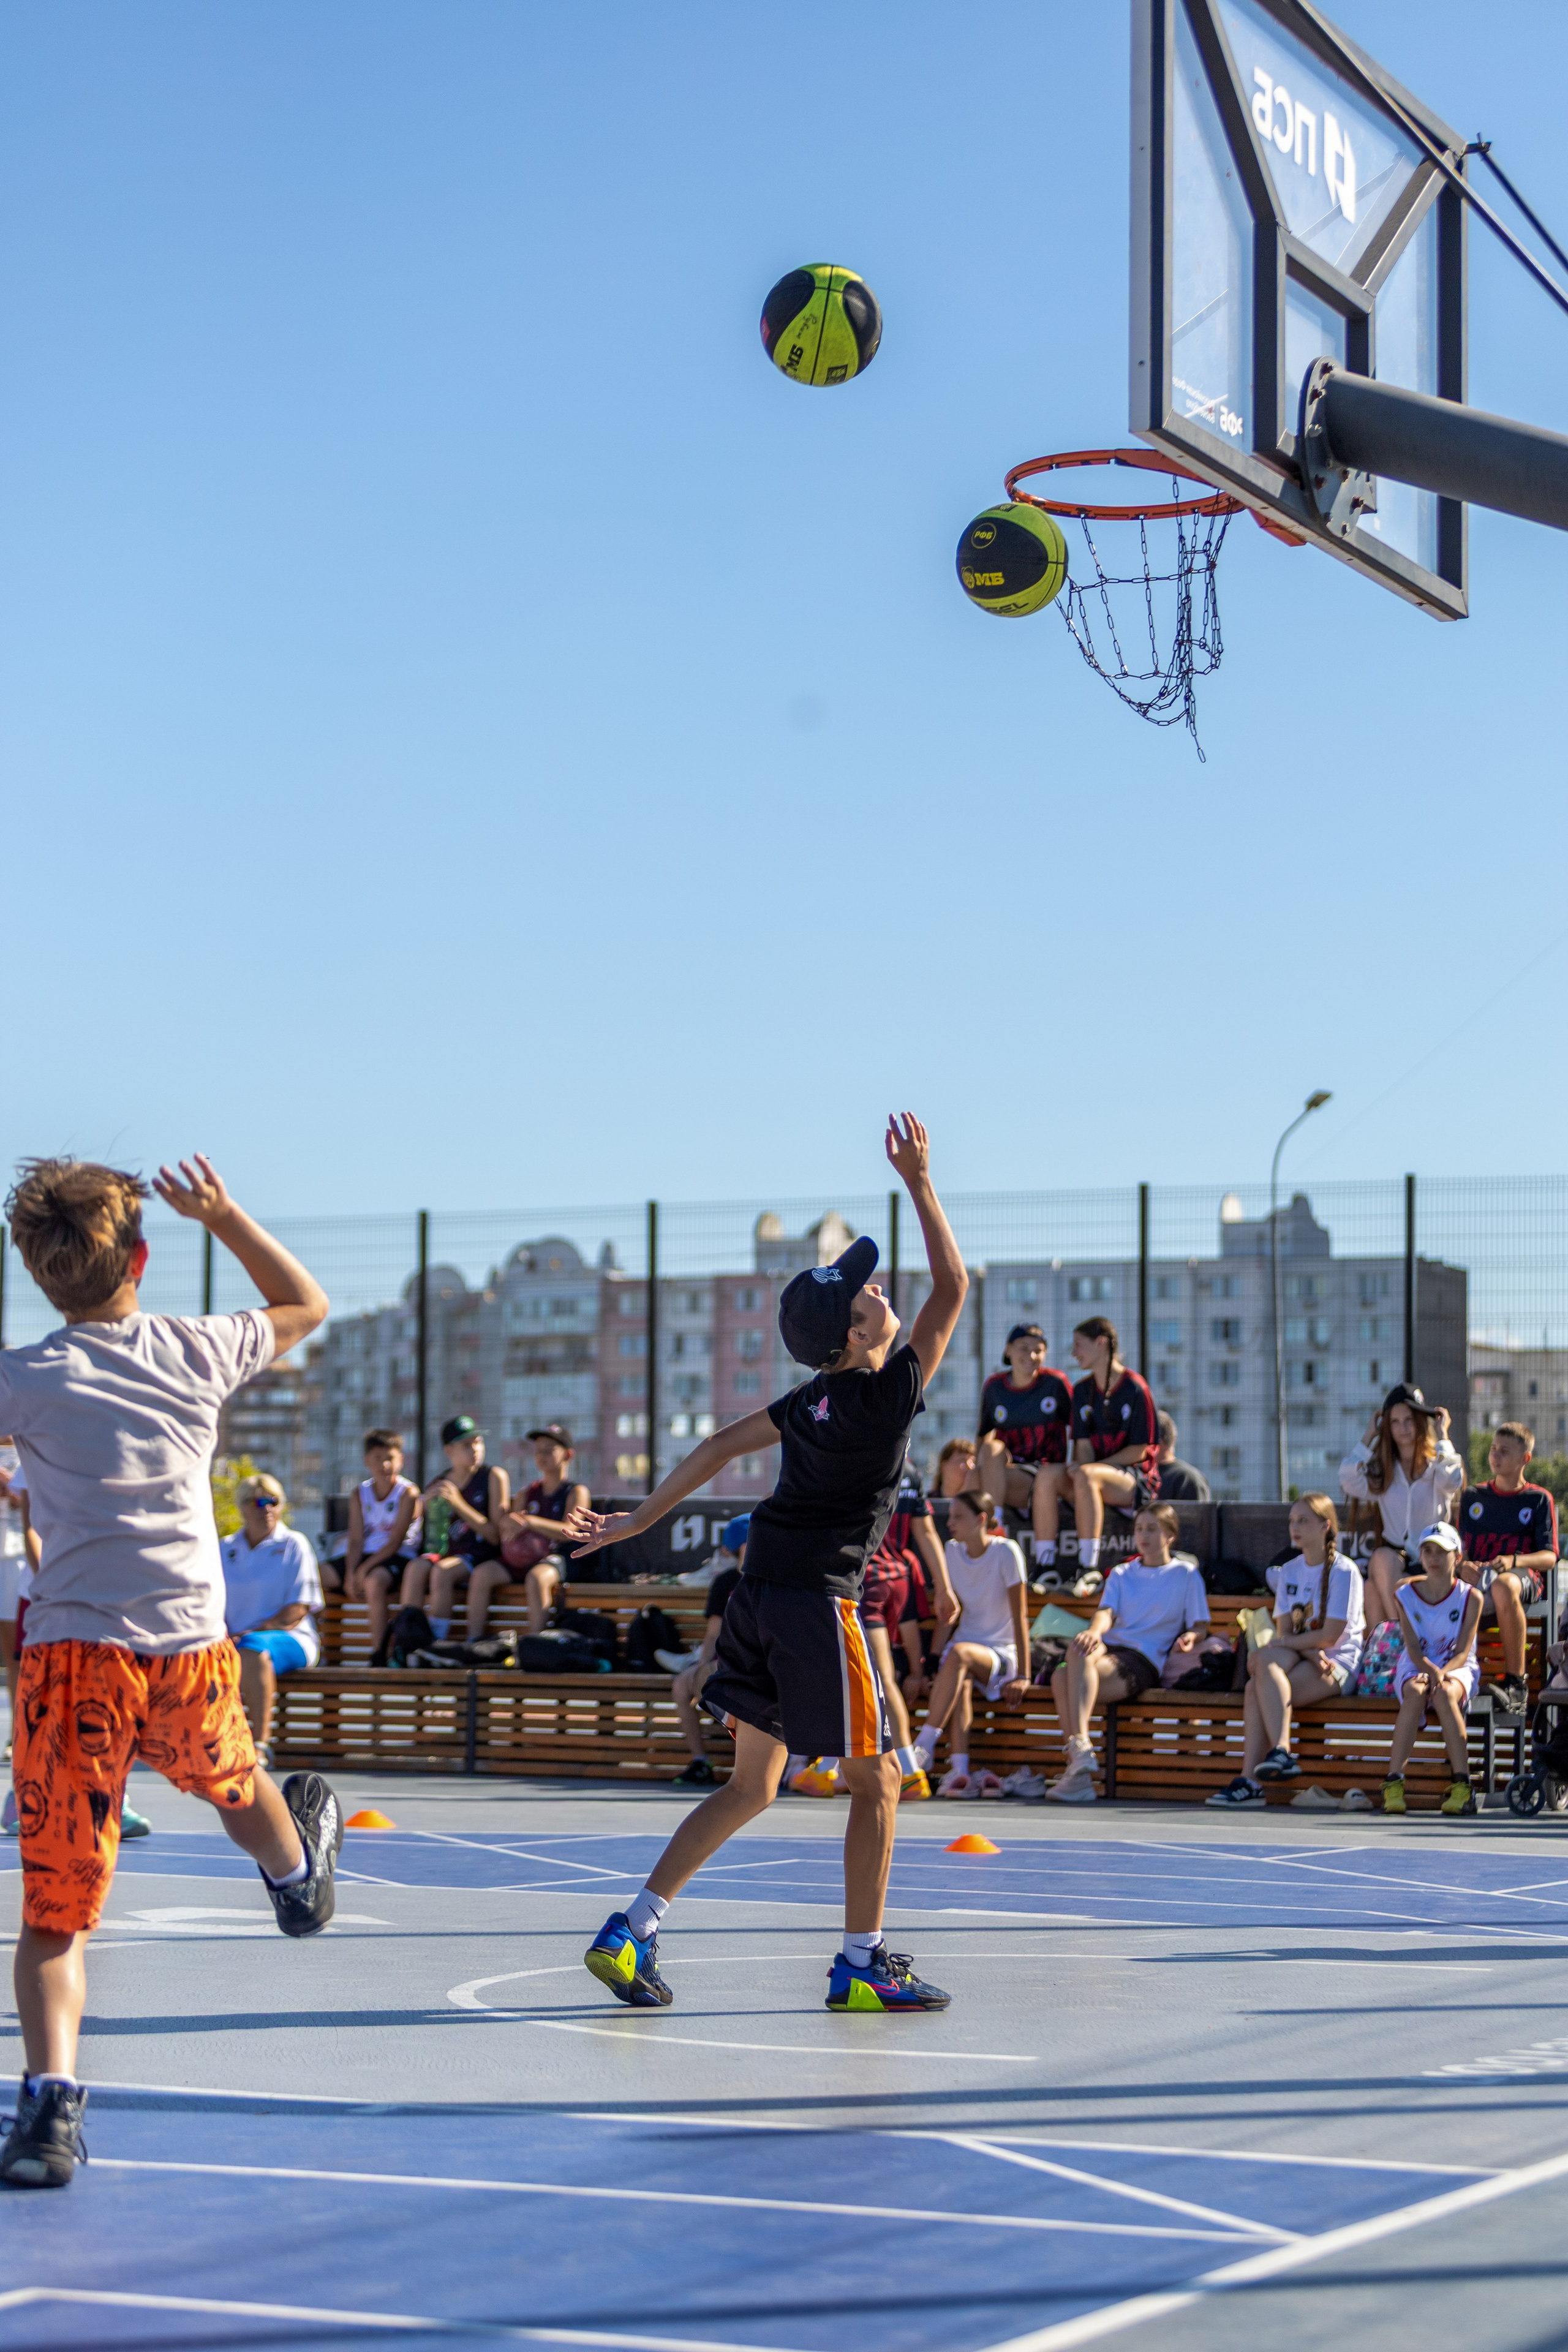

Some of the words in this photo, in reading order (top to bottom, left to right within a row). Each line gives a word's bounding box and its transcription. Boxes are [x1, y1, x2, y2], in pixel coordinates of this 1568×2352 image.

[974, 530, 993, 540] РФБ
[974, 571, 1005, 586] МБ
[1016, 1529, 1079, 1556] ПБ
[1336, 1530, 1376, 1558] ПС
